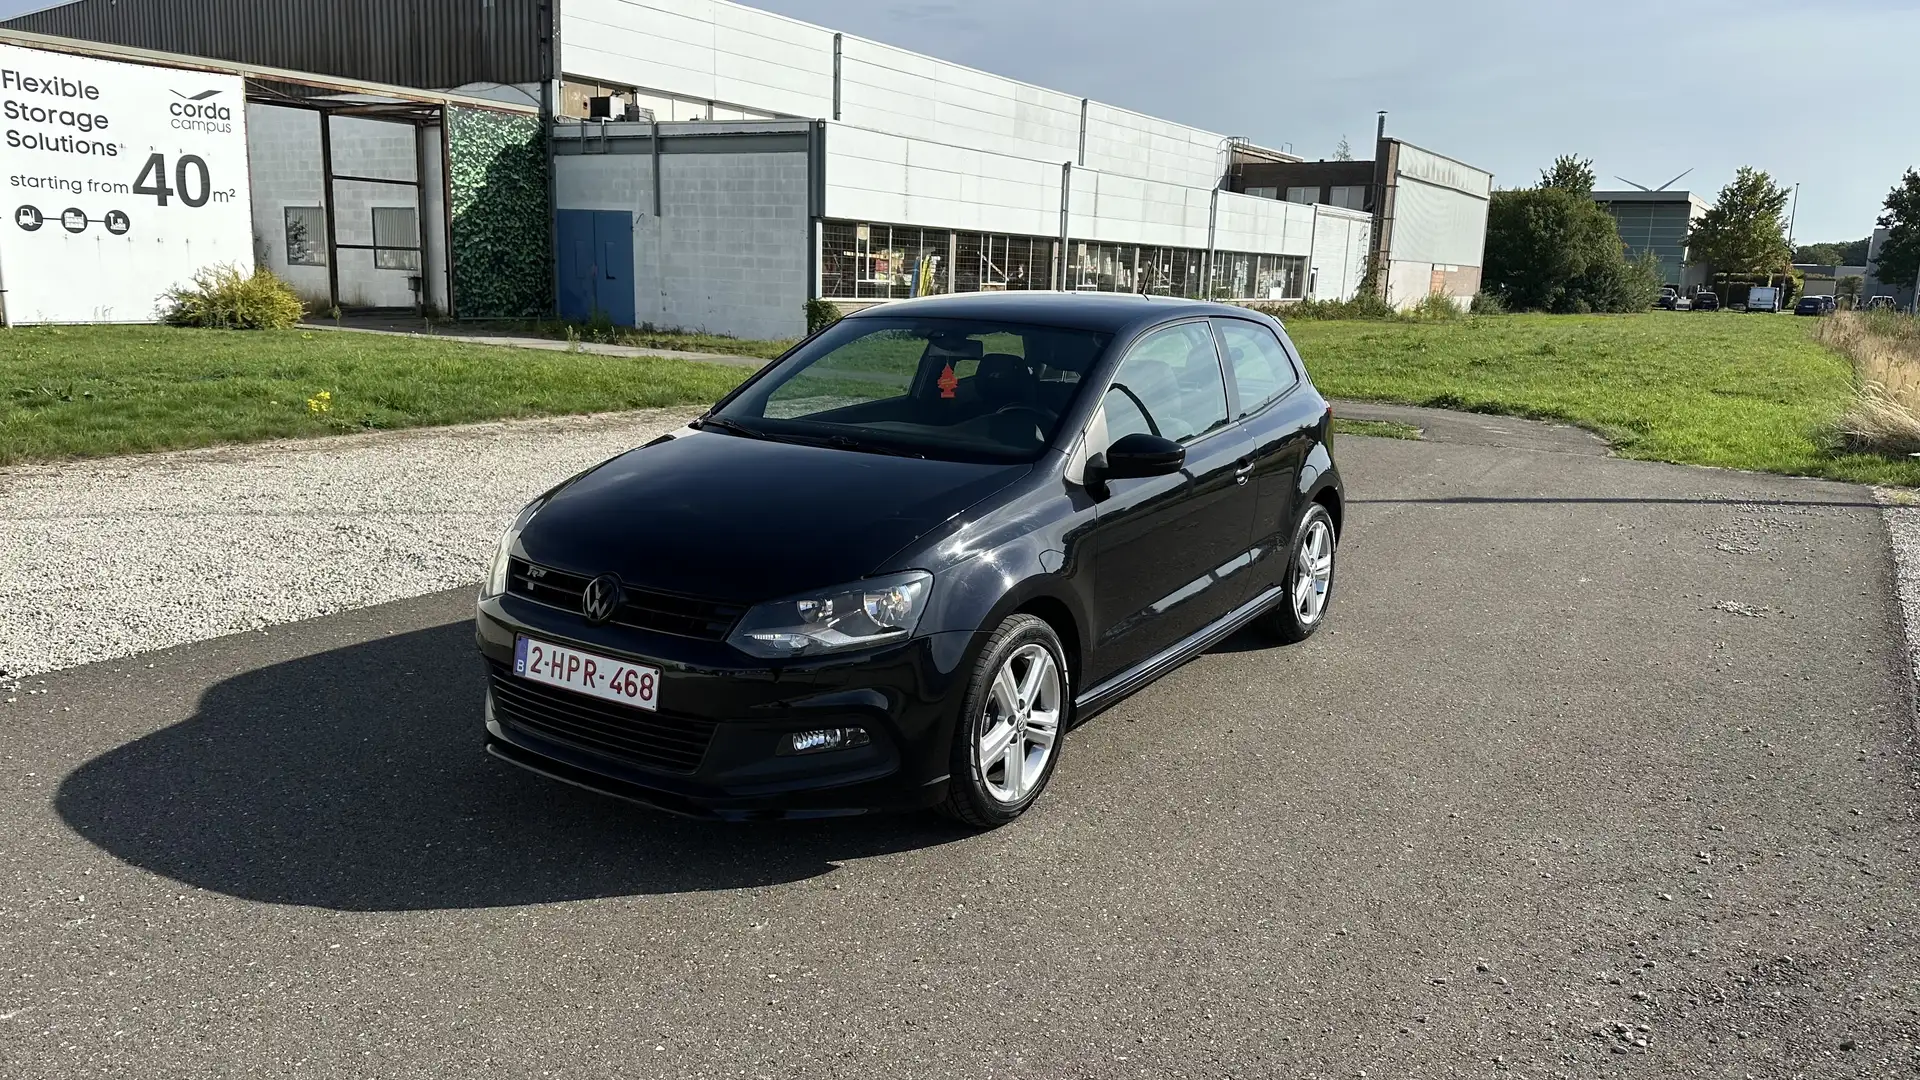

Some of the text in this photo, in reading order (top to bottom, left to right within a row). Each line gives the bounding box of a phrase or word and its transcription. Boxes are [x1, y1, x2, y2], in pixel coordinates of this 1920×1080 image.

[1, 69, 100, 100] Flexible
[3, 100, 109, 132] Storage
[169, 102, 231, 121] corda
[170, 118, 232, 134] campus
[6, 129, 118, 156] Solutions
[10, 174, 82, 194] starting
[87, 179, 129, 194] from
[132, 152, 211, 208] 40
[516, 646, 654, 701] B 2-HPR-468
